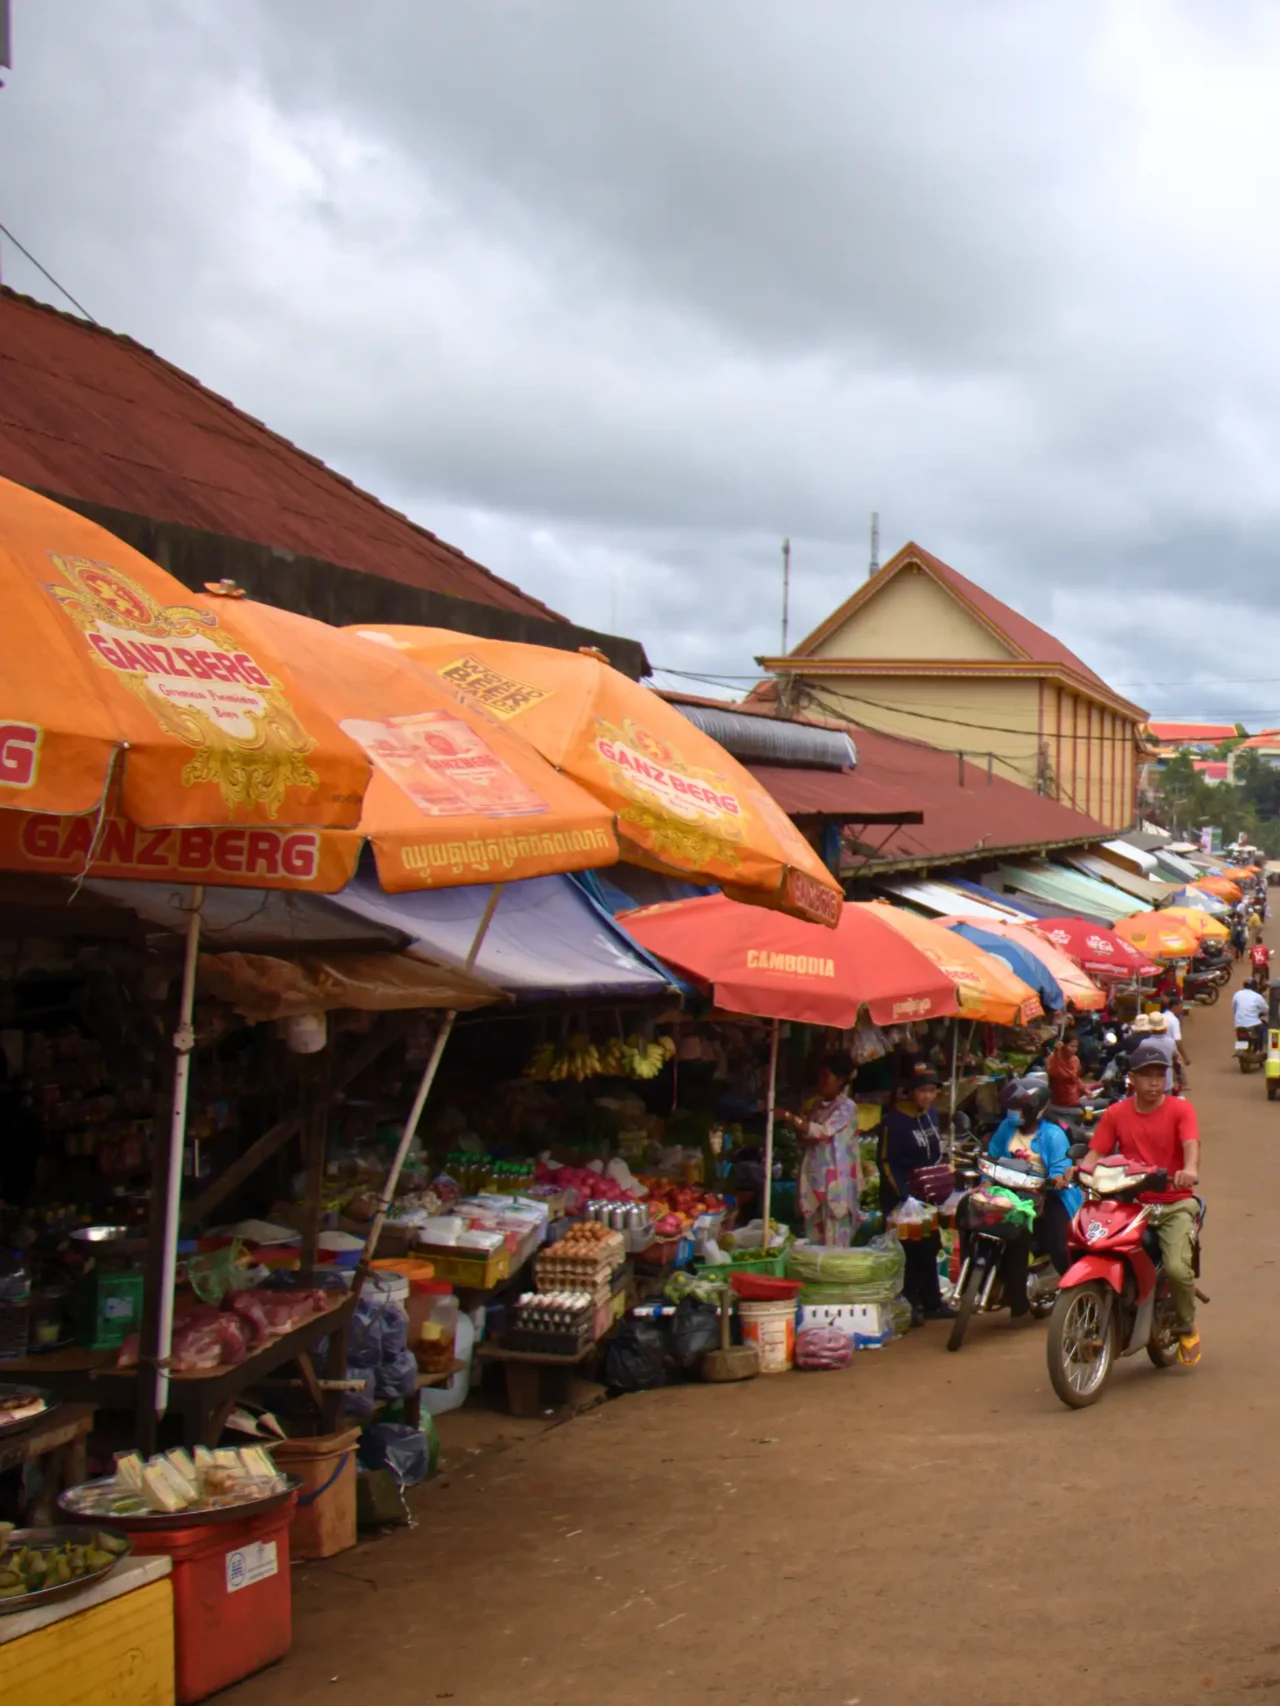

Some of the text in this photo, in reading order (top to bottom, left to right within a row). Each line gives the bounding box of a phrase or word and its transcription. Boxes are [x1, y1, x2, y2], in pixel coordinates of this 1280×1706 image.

[88, 632, 272, 687] GANZBERG
[462, 659, 544, 698] WORLD
[442, 666, 531, 707] BEER
[598, 740, 739, 815] GANZBERG
[22, 813, 318, 878] GANZBERG
[747, 949, 835, 979] CAMBODIA
